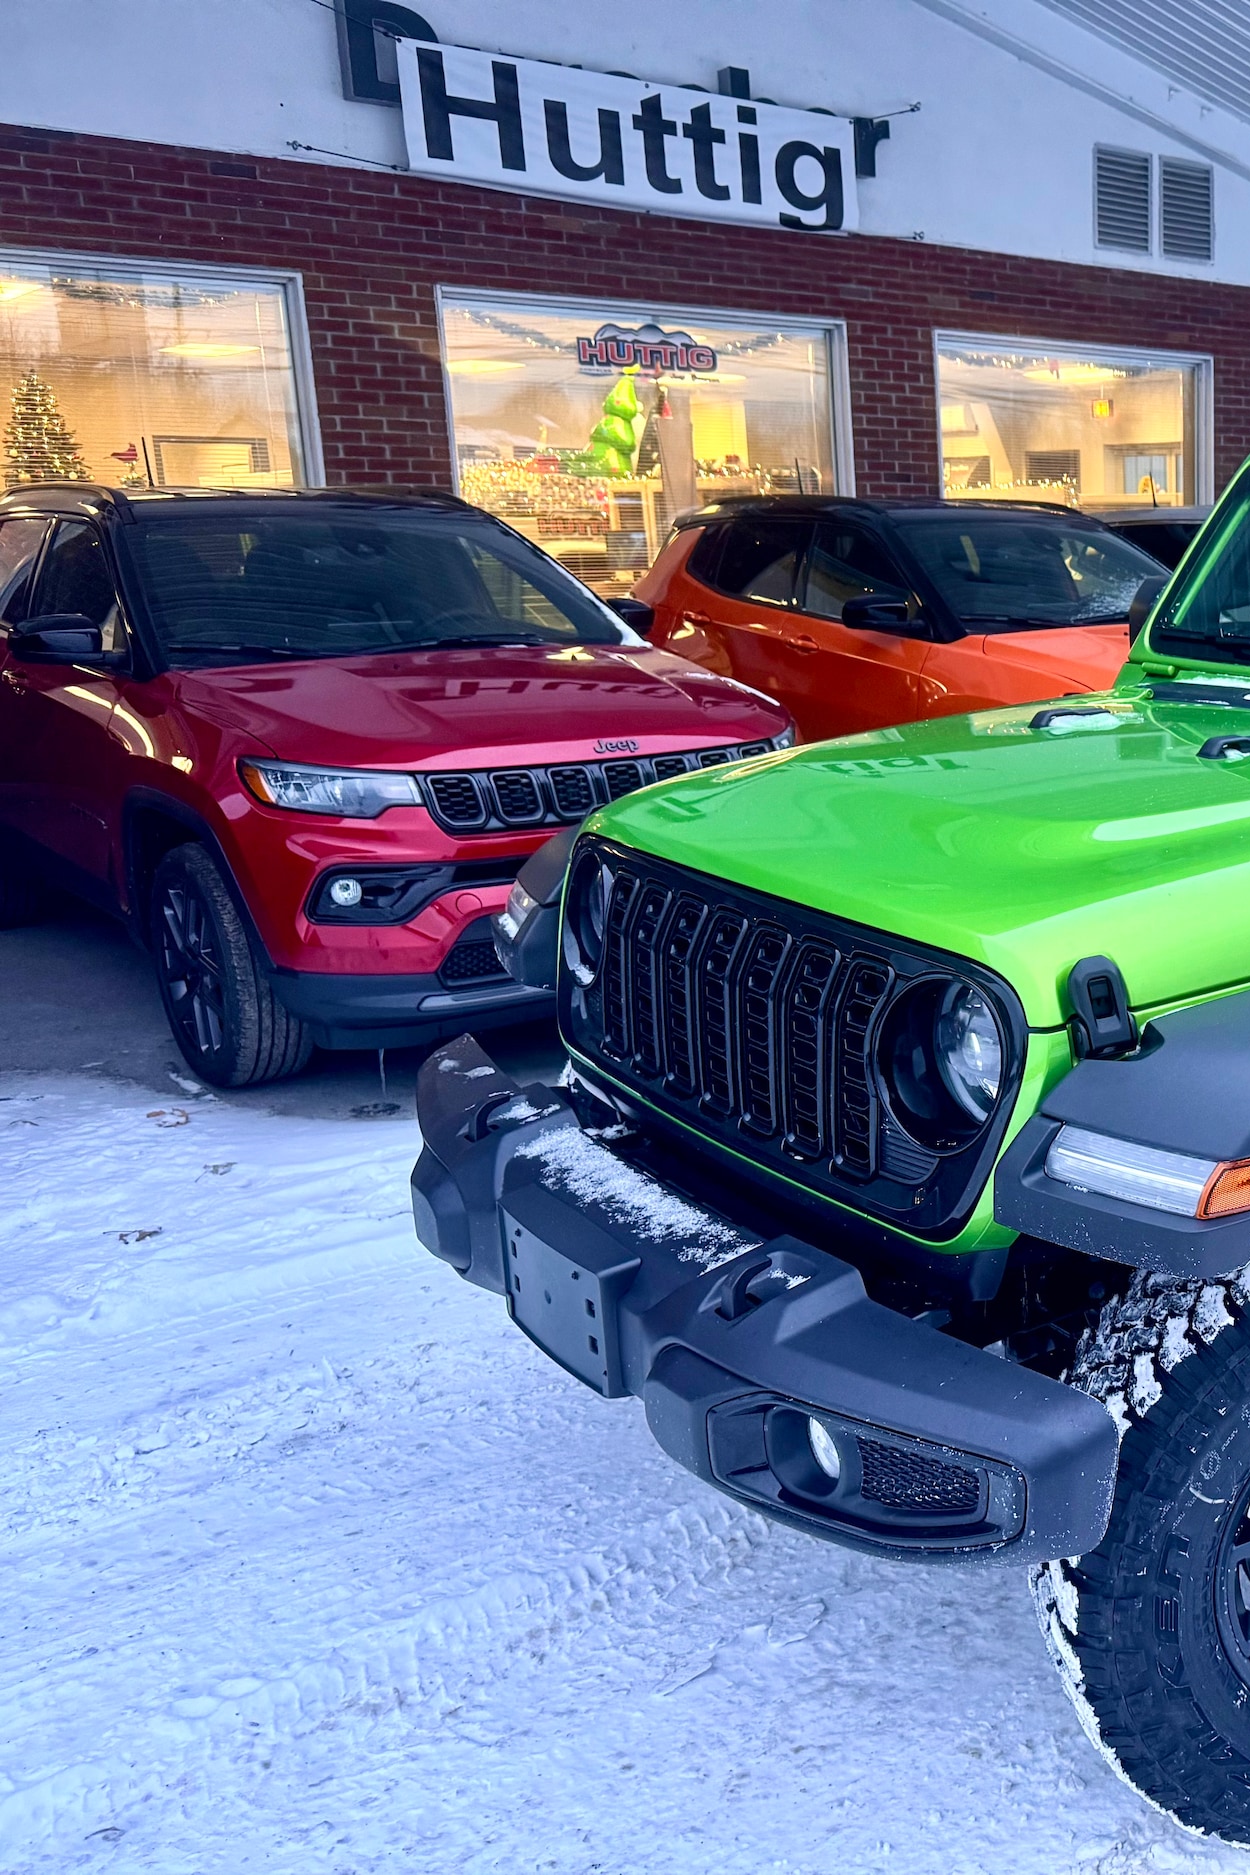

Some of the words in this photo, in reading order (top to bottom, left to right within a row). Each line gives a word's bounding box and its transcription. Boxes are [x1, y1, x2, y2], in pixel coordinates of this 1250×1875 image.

[415, 47, 843, 231] Huttig
[577, 337, 717, 373] HUTTIG
[593, 739, 639, 754] Jeep
